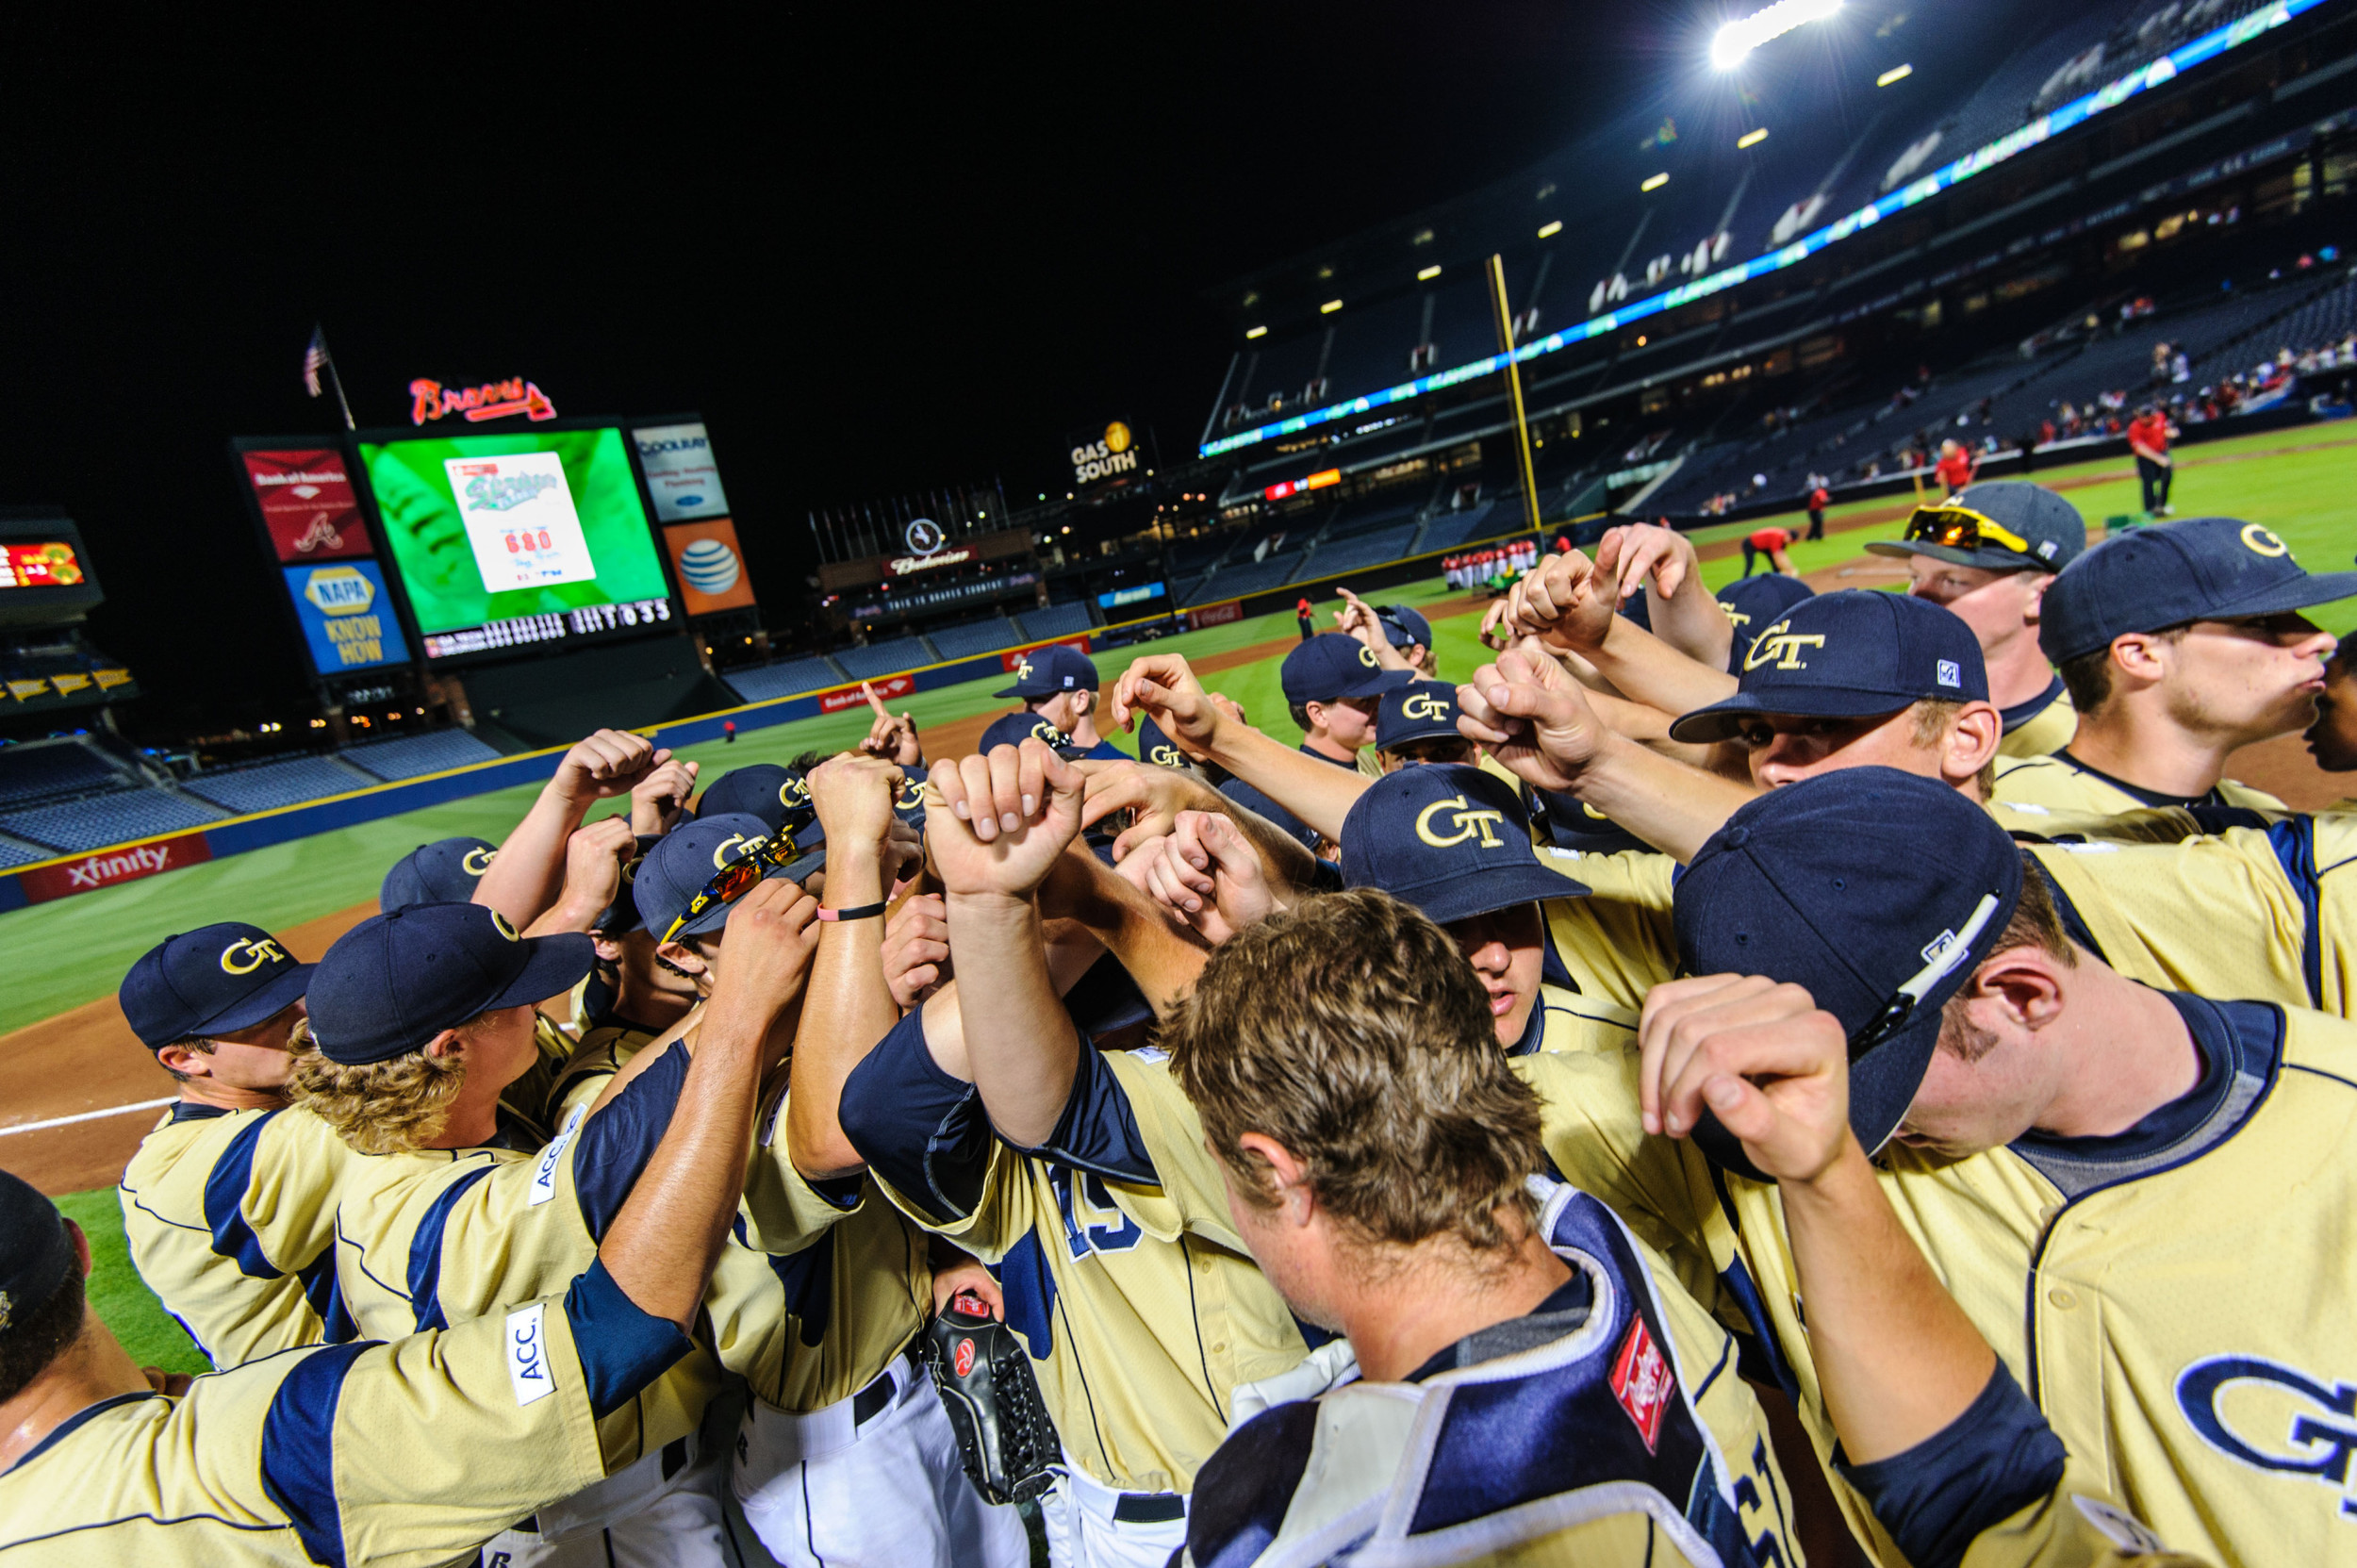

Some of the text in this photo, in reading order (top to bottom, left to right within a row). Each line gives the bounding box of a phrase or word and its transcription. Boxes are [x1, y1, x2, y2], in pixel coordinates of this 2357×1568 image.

[409, 375, 524, 424] Braves
[1071, 439, 1110, 466] GAS
[1075, 450, 1137, 484] SOUTH
[318, 580, 367, 604] NAPA
[323, 615, 382, 643] KNOW
[337, 638, 383, 665] HOW
[1743, 619, 1825, 671] GT
[824, 694, 847, 709] Bank
[1402, 692, 1450, 721] GT
[1150, 745, 1183, 767] GT
[1416, 795, 1504, 848] GT
[68, 847, 169, 886] xfinity
[221, 937, 285, 975] GT
